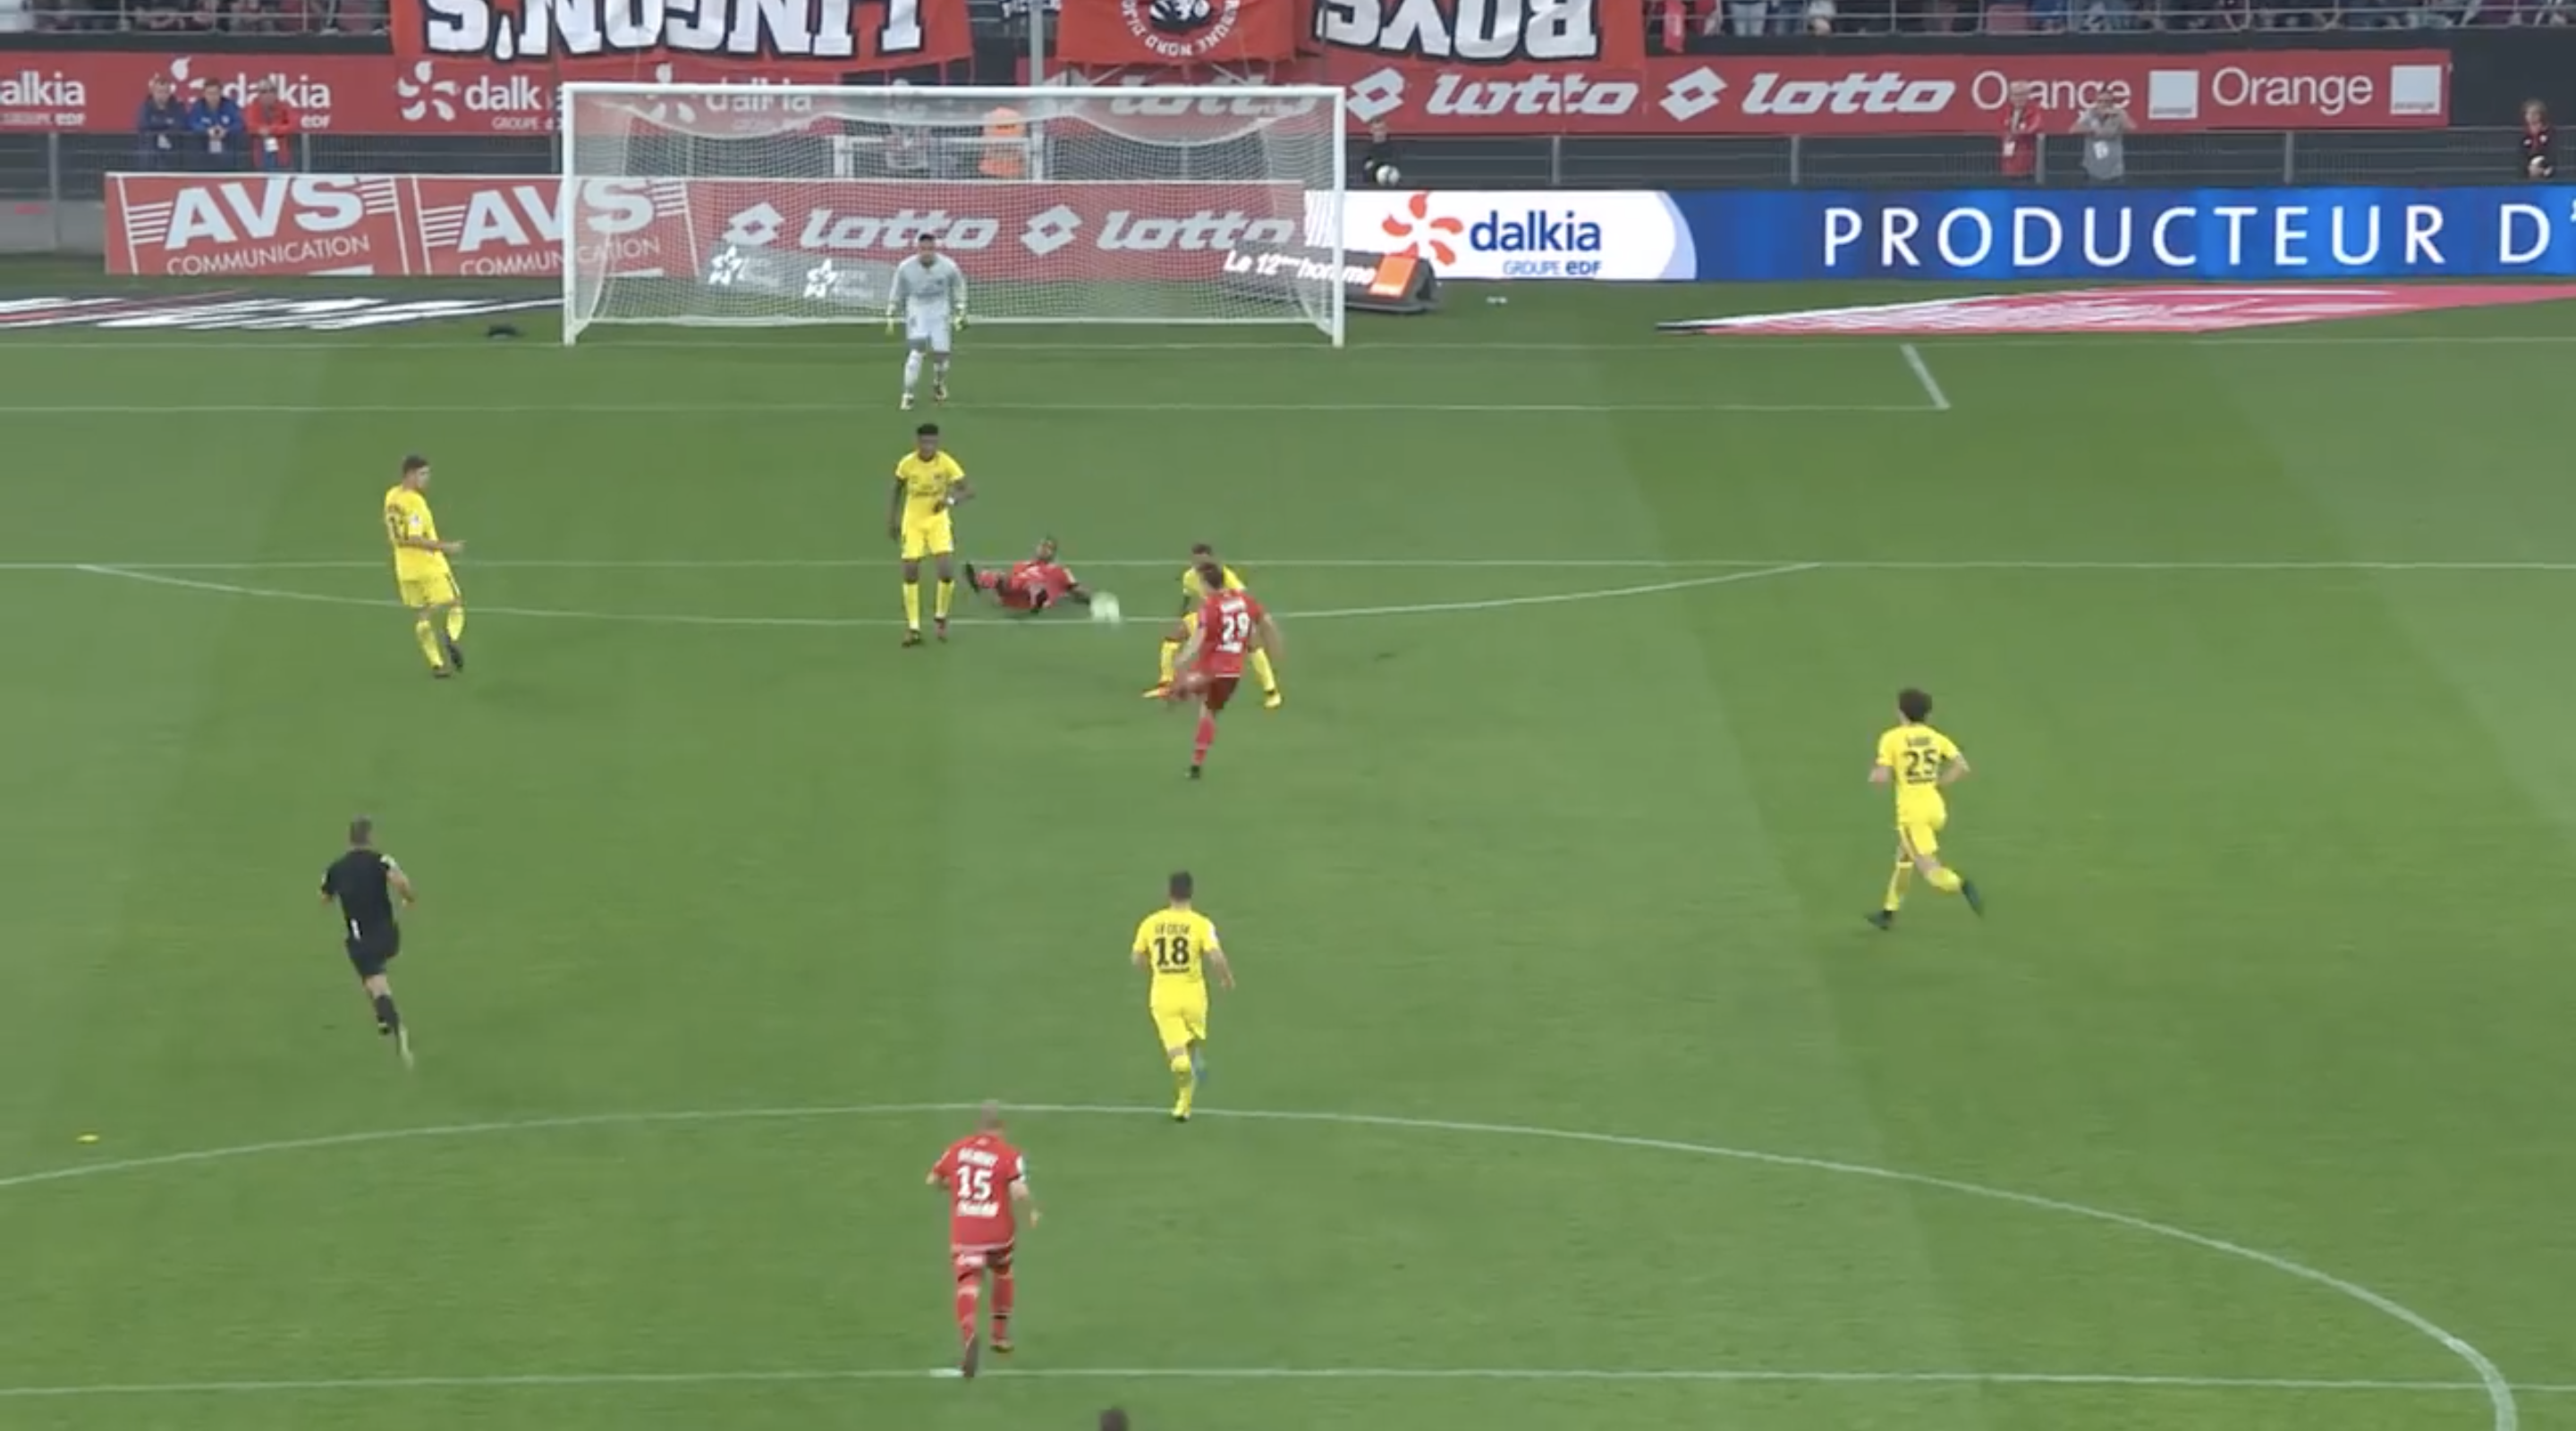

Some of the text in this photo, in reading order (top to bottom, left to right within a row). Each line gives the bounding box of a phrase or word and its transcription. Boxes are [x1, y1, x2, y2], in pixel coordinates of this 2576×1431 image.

[0, 72, 85, 106] alkia
[465, 75, 564, 111] dalk
[1426, 73, 1639, 114] lotto
[1741, 72, 1956, 114] lotto
[2212, 66, 2373, 115] Orange
[165, 174, 363, 250] AVS
[457, 177, 655, 252] AVS
[801, 208, 999, 250] lotto
[1097, 210, 1295, 250] lotto
[1470, 210, 1601, 251] dalkia
[166, 234, 370, 275] COMMUNICATION
[1825, 204, 2445, 267] PRODUCTEUR
[1503, 260, 1561, 275] GROUPE
[1222, 612, 1250, 642] 29
[1904, 749, 1937, 776] 25
[1154, 936, 1190, 966] 18
[957, 1165, 993, 1200] 15
